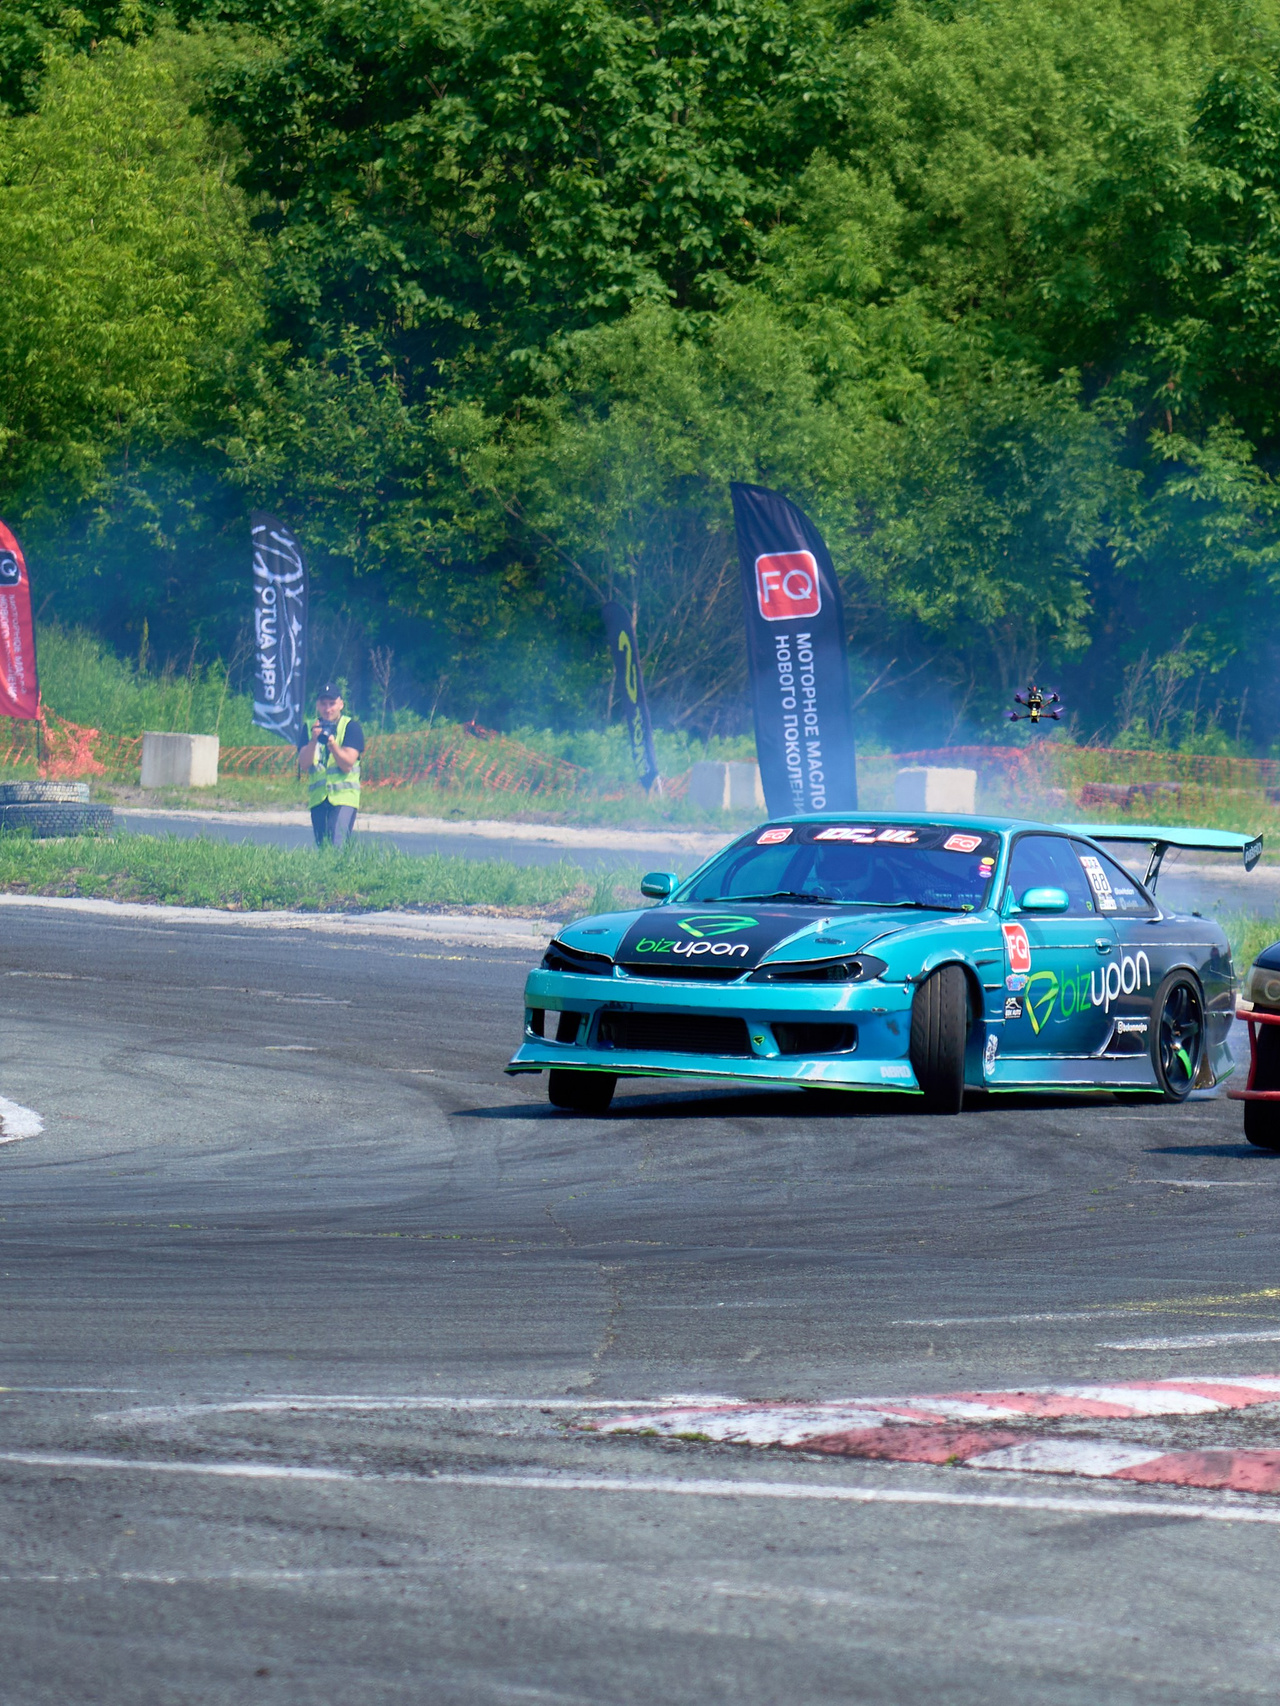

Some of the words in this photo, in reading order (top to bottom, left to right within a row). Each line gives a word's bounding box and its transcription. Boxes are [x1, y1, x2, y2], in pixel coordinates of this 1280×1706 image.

[0, 559, 18, 577] Q
[761, 569, 813, 603] FQ
[775, 635, 797, 709] НОВОГО
[796, 632, 820, 737] МОТОРНОЕ
[783, 714, 806, 816] ПОКОЛЕНИ
[806, 741, 826, 810] МАСЛО
[762, 831, 788, 842] FQ
[949, 837, 977, 848] FQ
[1092, 873, 1109, 891] 88
[636, 937, 750, 958] bizupon
[1008, 935, 1028, 960] FQ
[1061, 950, 1151, 1018] bizupon
